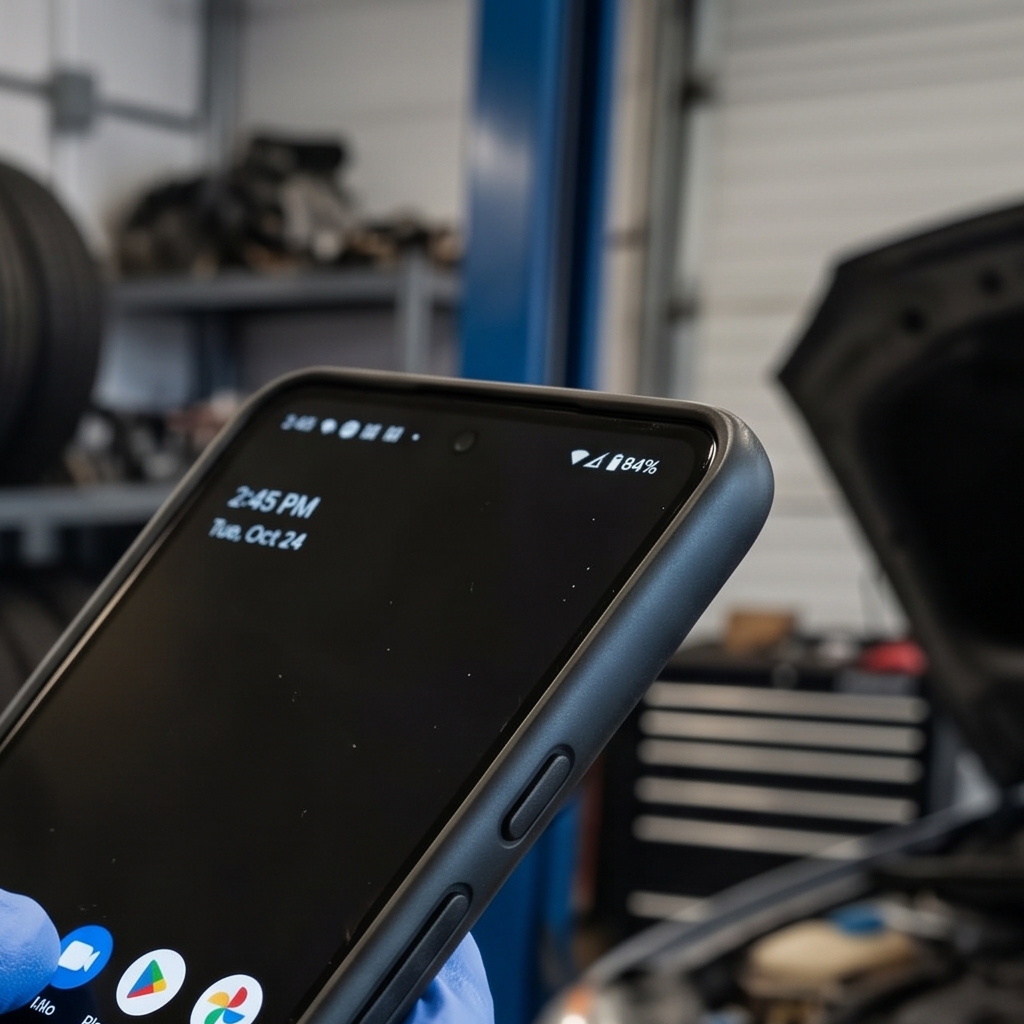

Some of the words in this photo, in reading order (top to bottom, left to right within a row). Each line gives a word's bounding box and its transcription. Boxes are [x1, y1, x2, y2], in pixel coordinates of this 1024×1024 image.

[620, 456, 660, 475] 84%
[227, 485, 282, 513] 2:45
[276, 492, 321, 519] PM
[244, 524, 282, 547] Oct
[278, 530, 307, 550] 24
